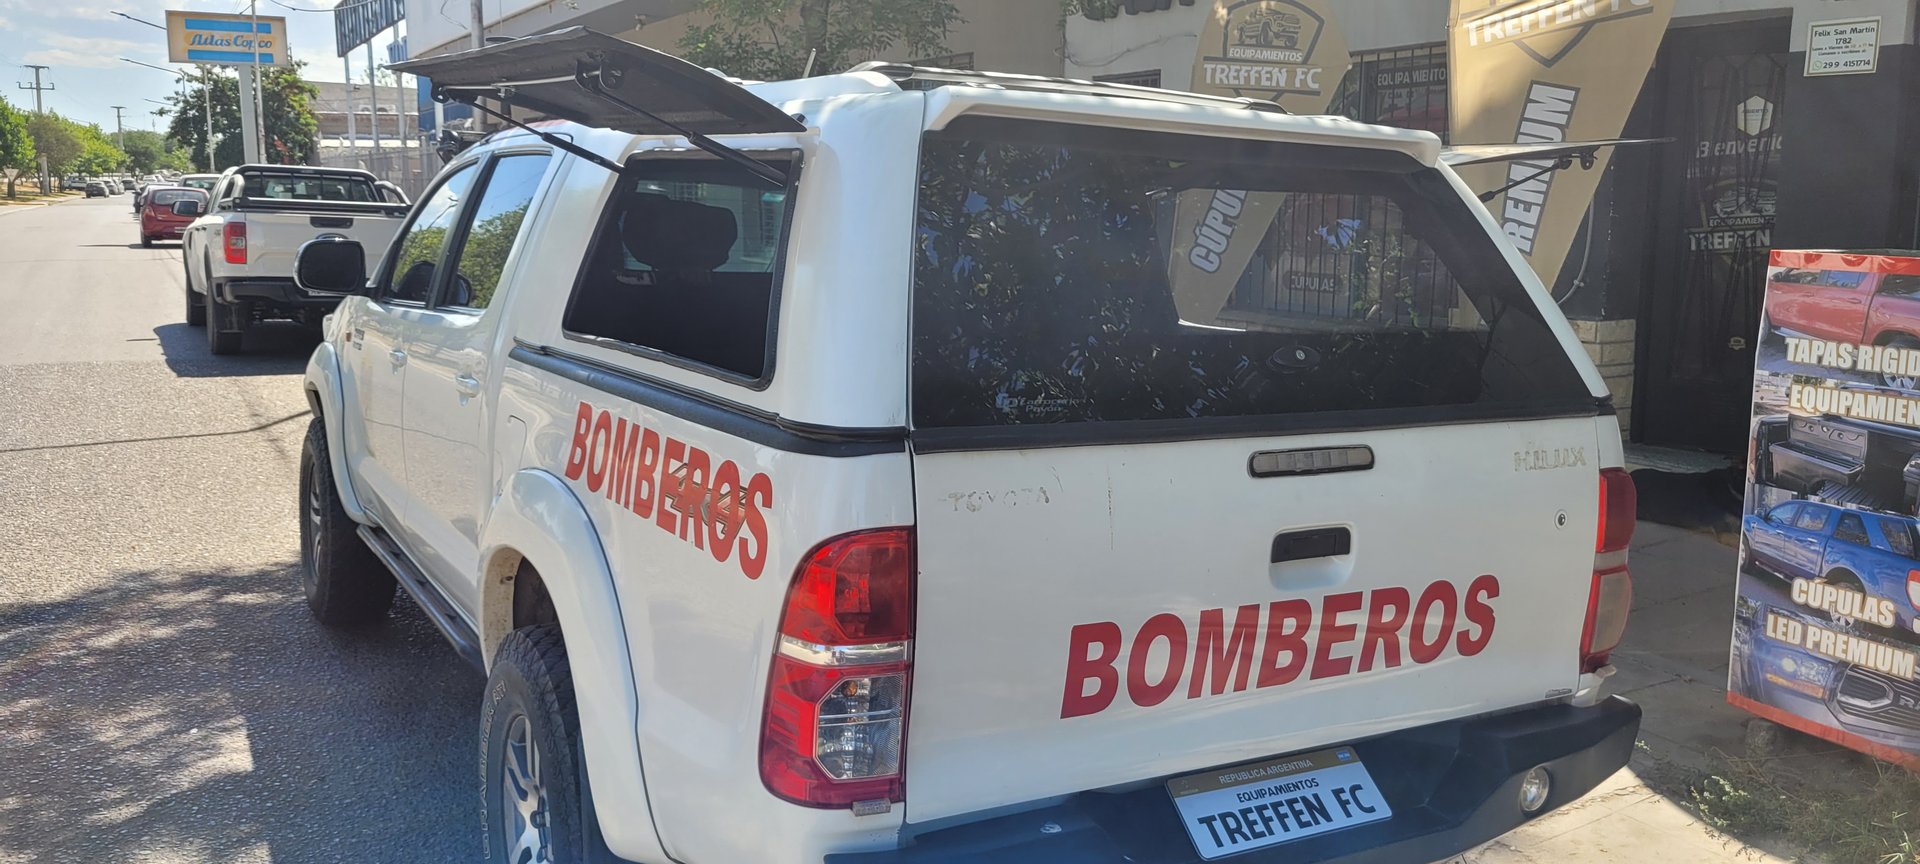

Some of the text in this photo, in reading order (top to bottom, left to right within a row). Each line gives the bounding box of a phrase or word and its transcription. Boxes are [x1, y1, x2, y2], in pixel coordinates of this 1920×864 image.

[190, 33, 232, 46] Atlas
[1834, 28, 1847, 36] San
[1835, 37, 1852, 45] 1782
[1229, 48, 1303, 62] EQUIPAMIENTOS
[1203, 64, 1323, 89] TREFFEN FC
[1785, 336, 1854, 369] TAPAS
[565, 401, 773, 580] BOMBEROS
[1791, 577, 1895, 627] CÚPULAS
[1060, 574, 1500, 719] BOMBEROS
[1765, 613, 1915, 679] LED PREMIUM
[1266, 759, 1313, 775] ARGENTINA
[1236, 777, 1320, 803] EQUIPAMIENTOS
[1197, 783, 1377, 848] TREFFEN FC
